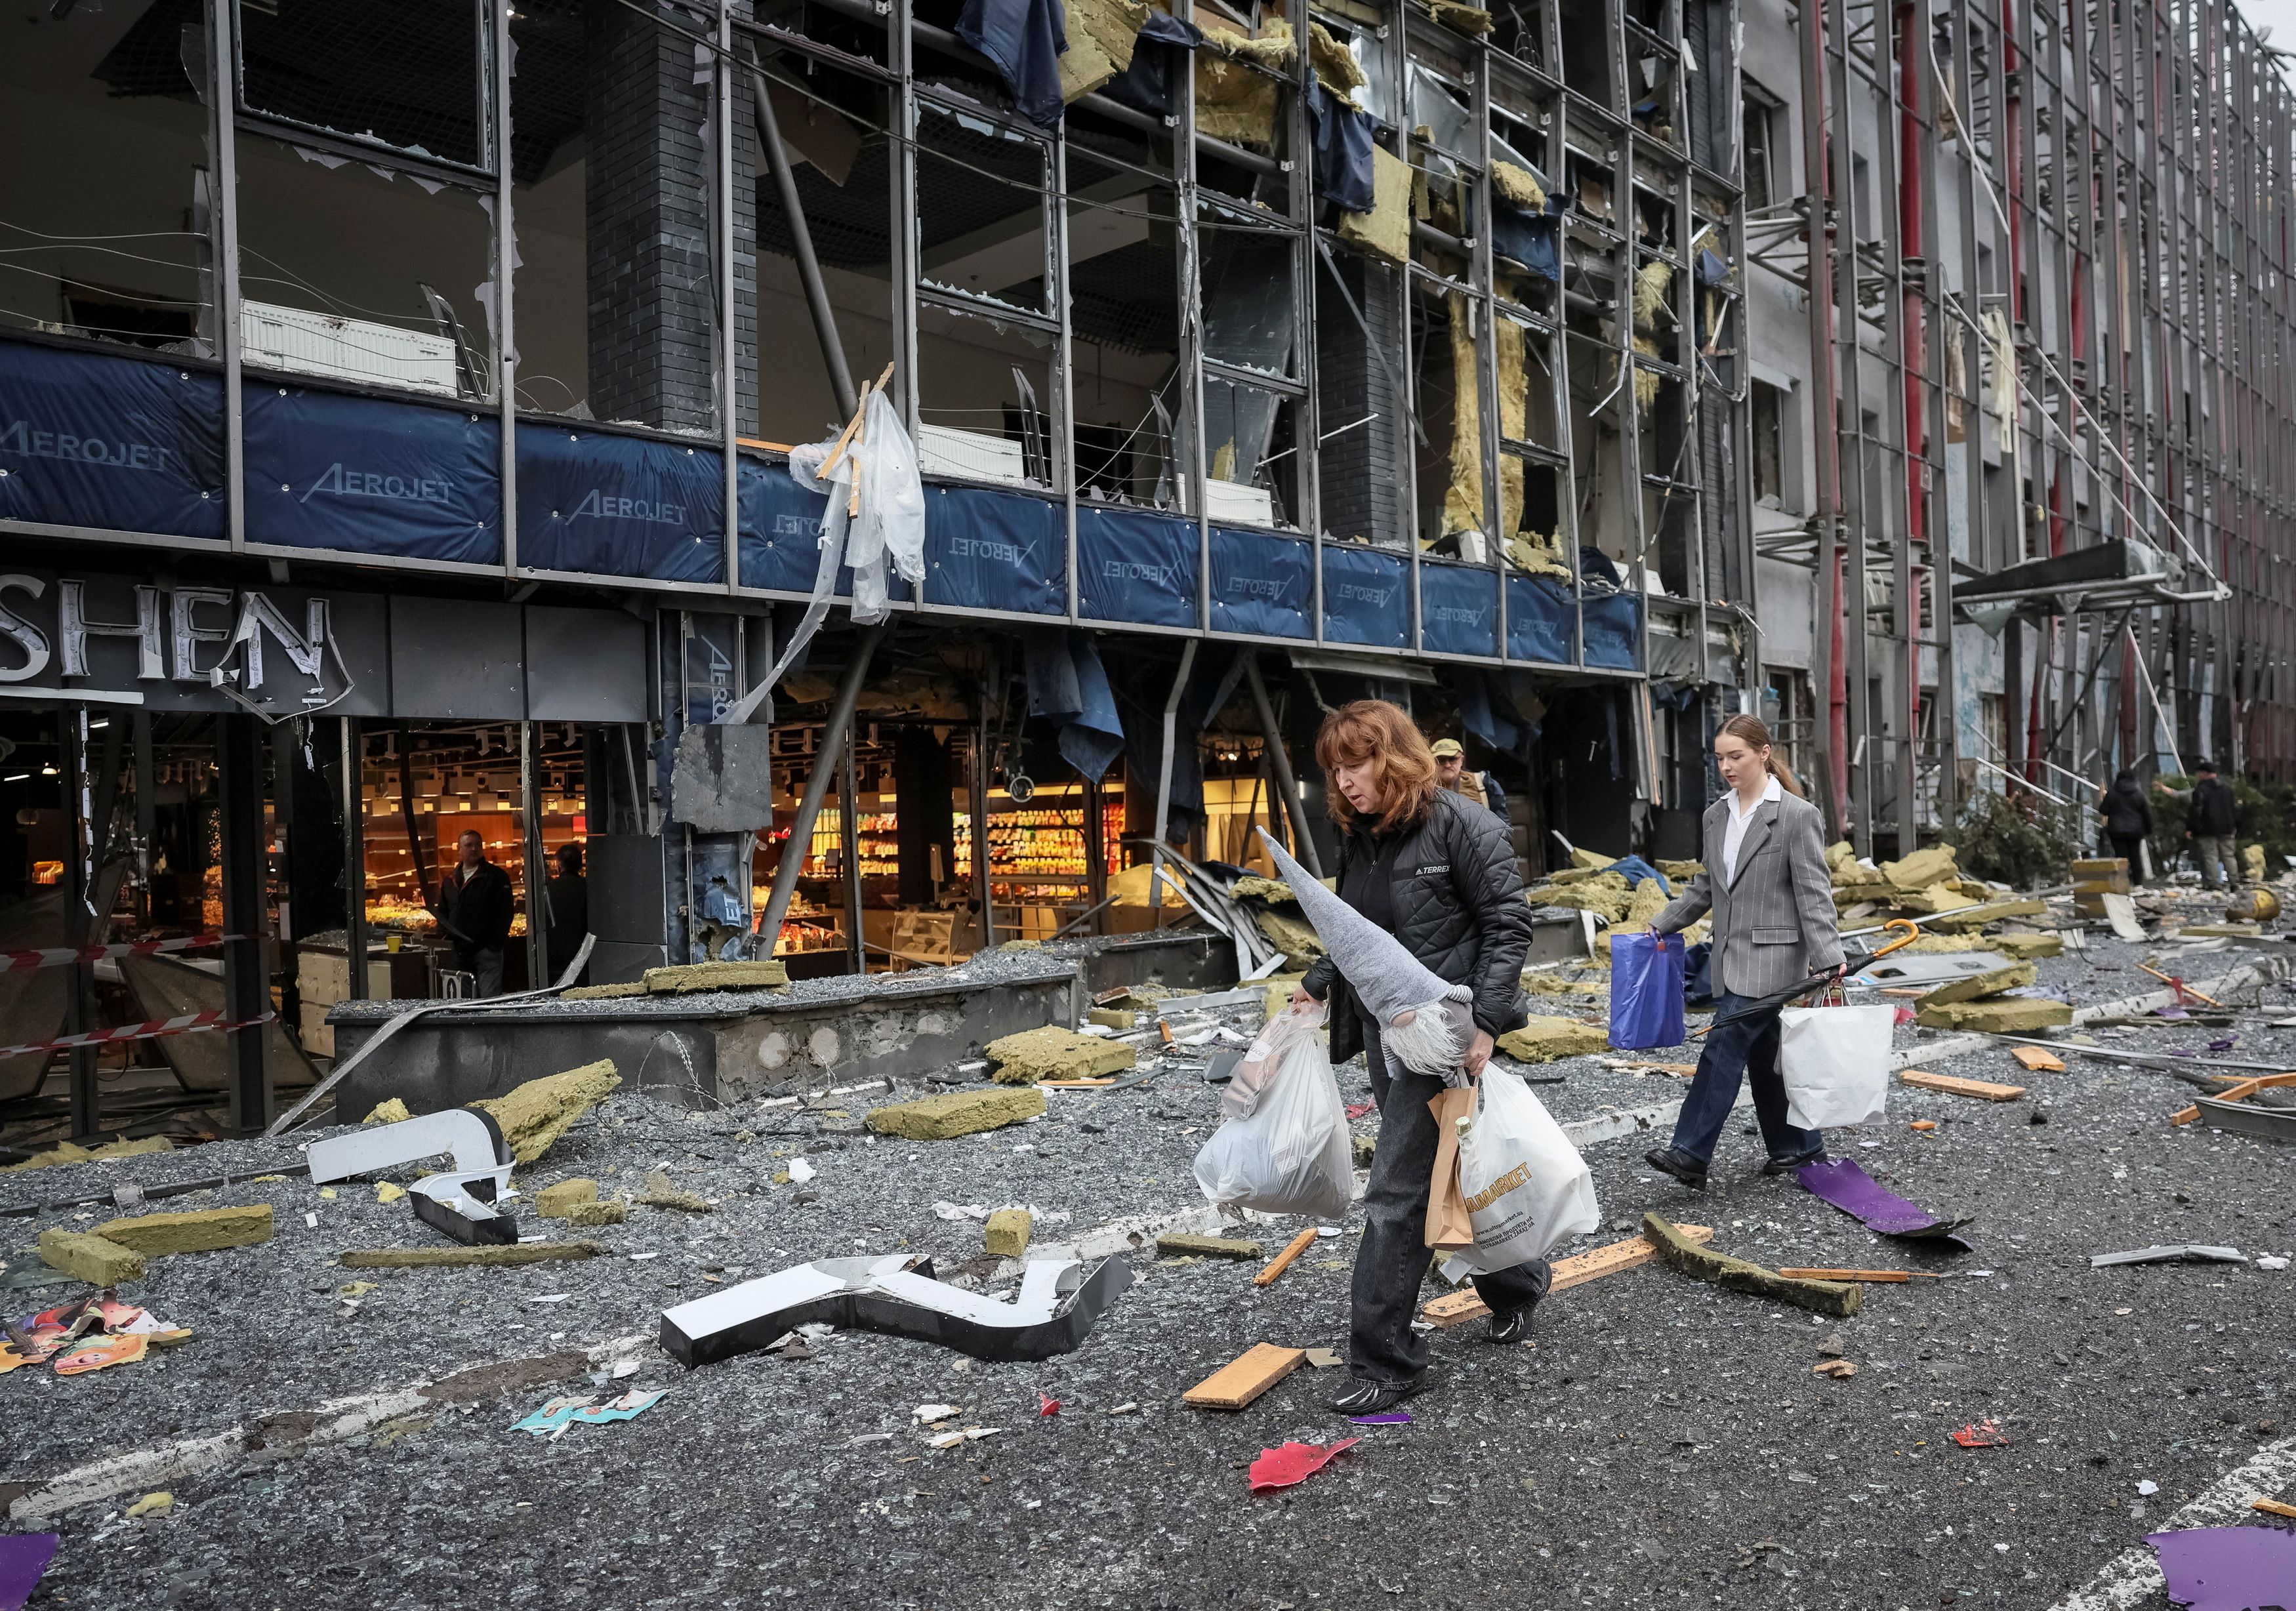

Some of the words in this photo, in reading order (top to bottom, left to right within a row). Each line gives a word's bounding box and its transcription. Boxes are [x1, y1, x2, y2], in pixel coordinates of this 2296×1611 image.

[0, 420, 171, 472] AEROJET
[299, 462, 454, 504] AEROJET
[565, 489, 687, 525] AEROJET
[949, 537, 1038, 568] AEROJET
[1103, 559, 1181, 587] AEROJET
[1226, 575, 1295, 600] AEROJET
[1337, 584, 1397, 609] AEROJET
[1435, 605, 1486, 628] AEROJET
[701, 634, 732, 719] AERO
[1424, 865, 1450, 874] TERREX
[1476, 1211, 1524, 1236] www.ultramarket.ua
[1477, 1233, 1504, 1246] ЗАМОВЛЯЙ
[1502, 1221, 1527, 1238] ПРОДУКТИ
[1526, 1215, 1534, 1225] НА
[1481, 1221, 1535, 1250] ULTRAMARKET.ZAKAZ.UA
